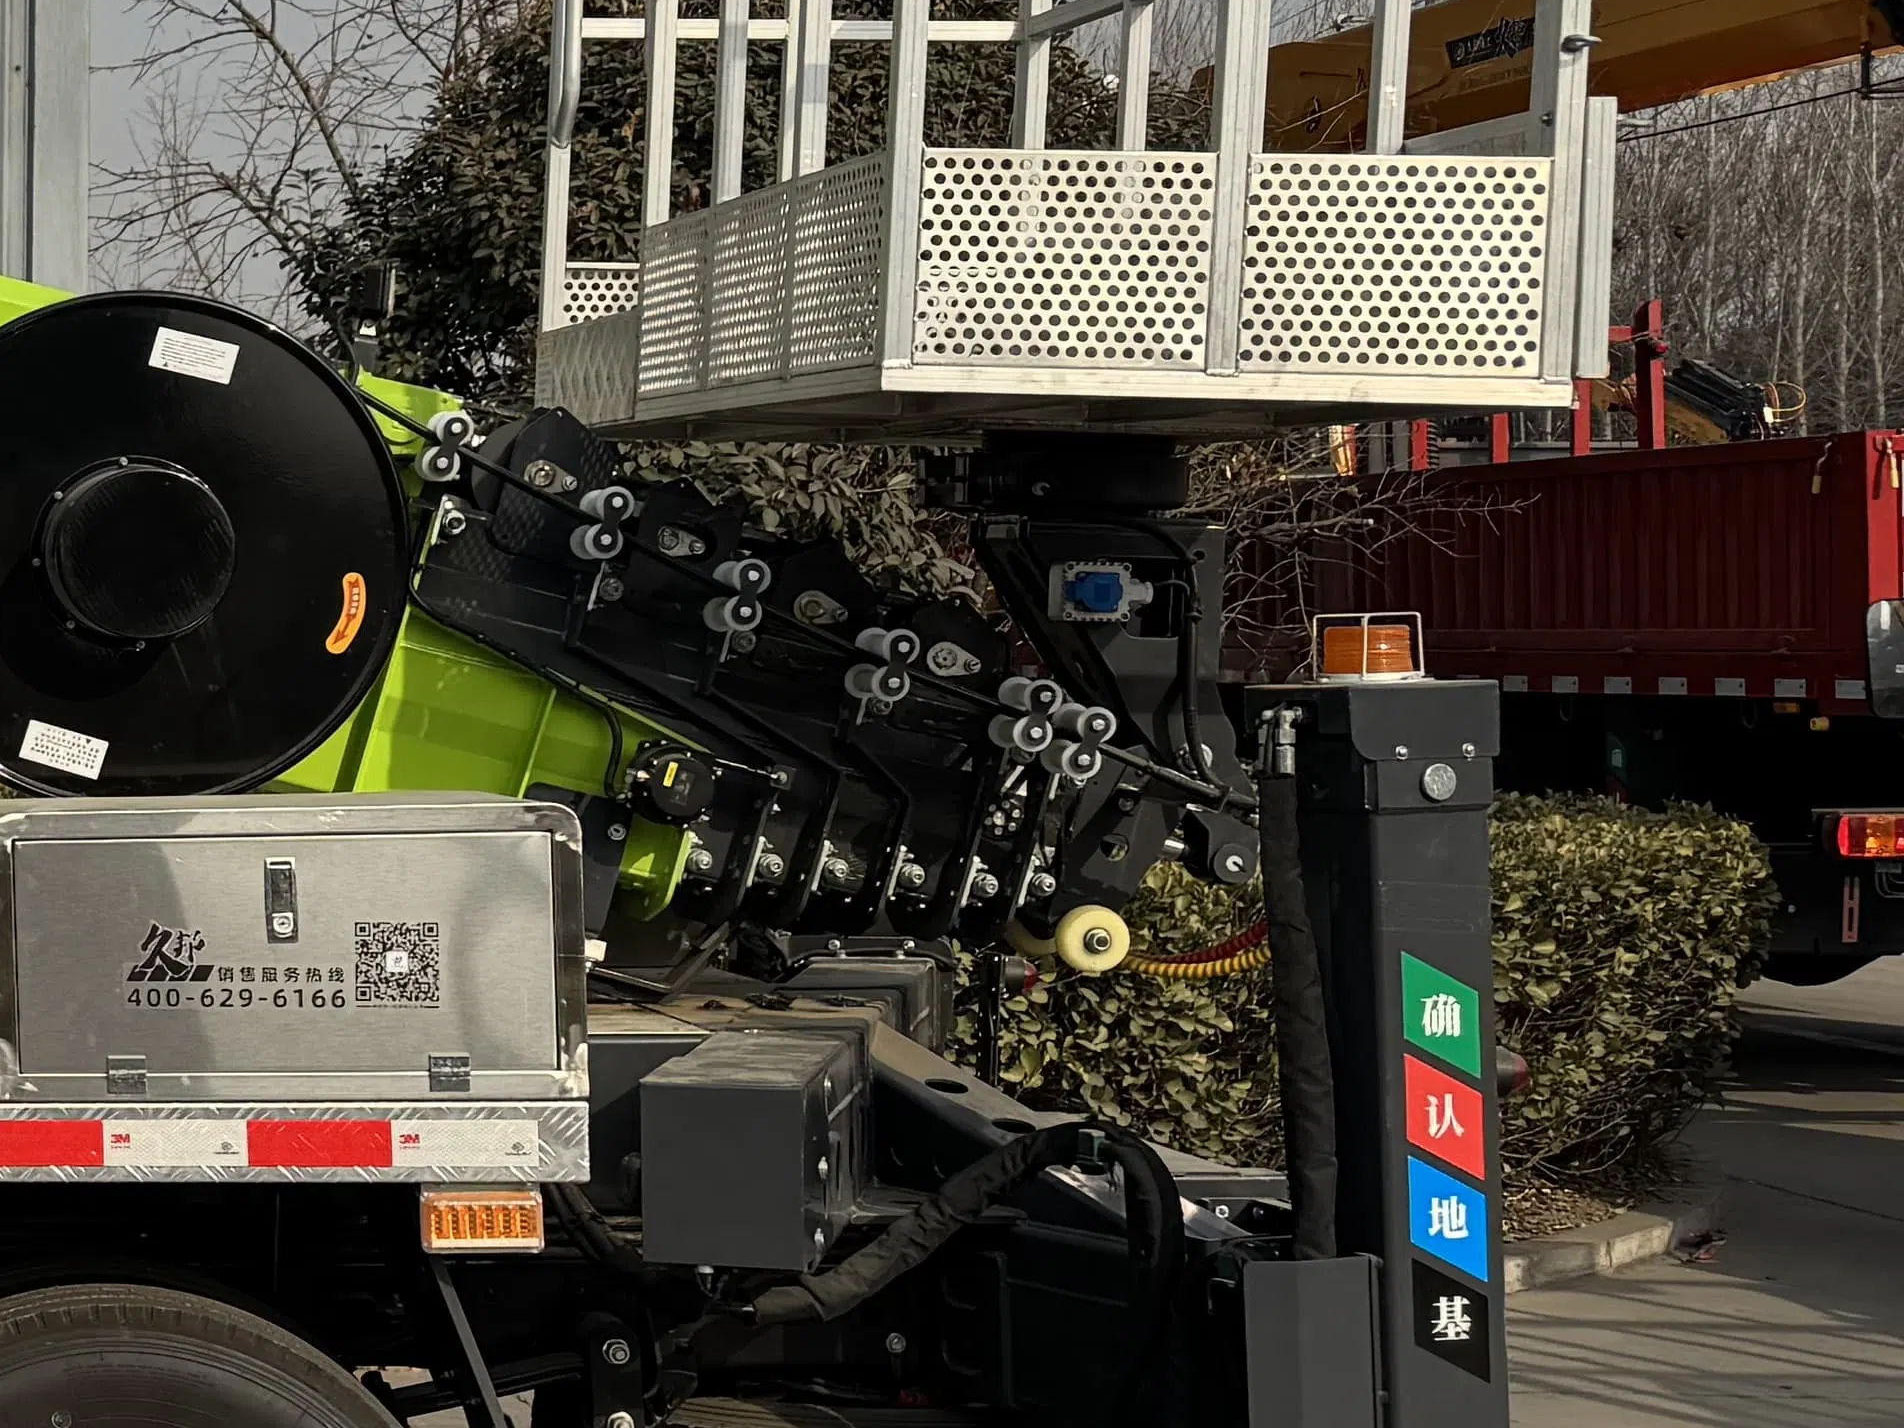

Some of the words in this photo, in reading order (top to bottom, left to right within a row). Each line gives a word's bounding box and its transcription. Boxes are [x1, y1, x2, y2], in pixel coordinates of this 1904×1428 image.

[218, 967, 345, 984] 销售服务热线
[127, 988, 346, 1008] 400-629-6166
[112, 1134, 131, 1144] 3M
[399, 1134, 419, 1144] 3M
